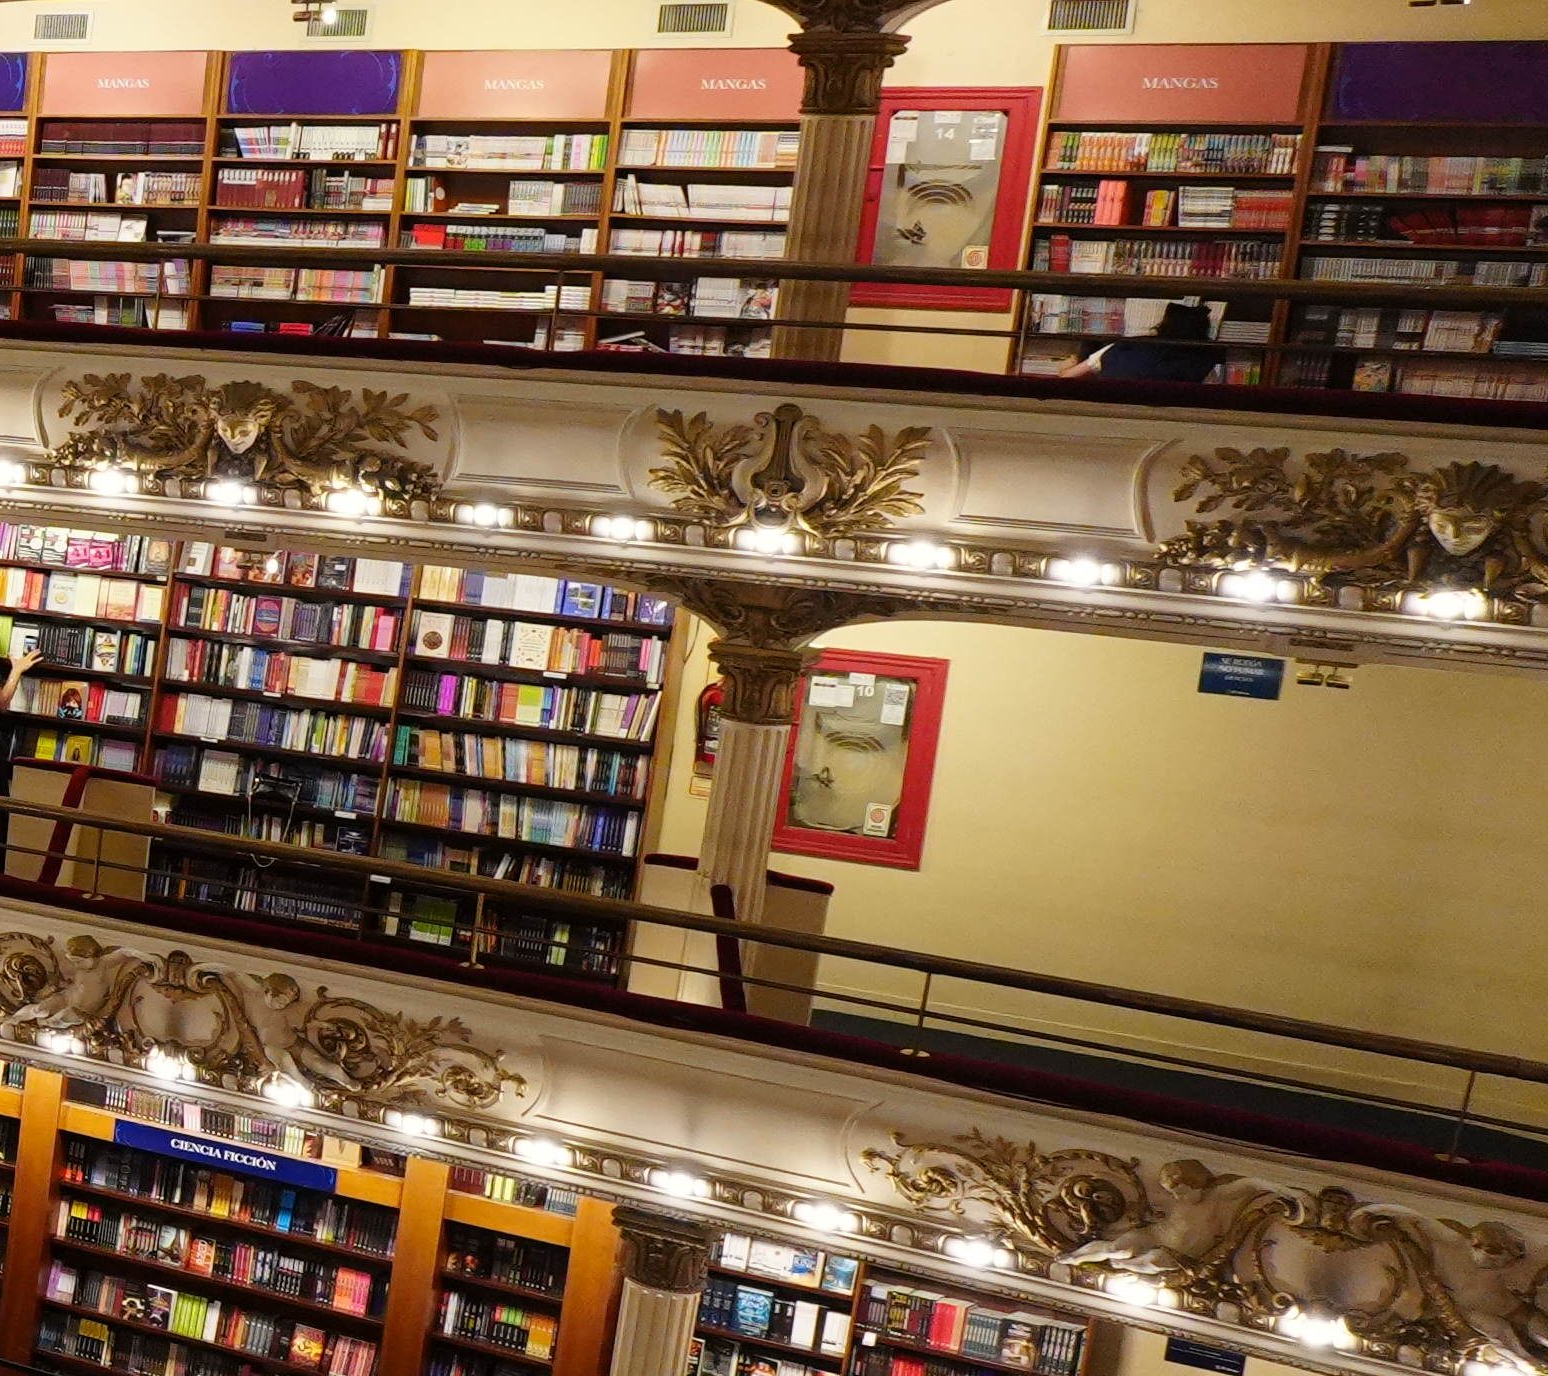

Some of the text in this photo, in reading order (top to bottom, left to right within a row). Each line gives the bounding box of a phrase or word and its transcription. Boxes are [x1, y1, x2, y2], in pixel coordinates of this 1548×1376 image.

[97, 79, 150, 89] MANGAS
[484, 79, 545, 91] MANGAS
[701, 78, 767, 90] MANGAS
[1142, 77, 1219, 89] MANGAS
[935, 127, 956, 141] 14
[857, 685, 875, 697] 10
[170, 1137, 278, 1172] CIENCIA FICCIÓN
